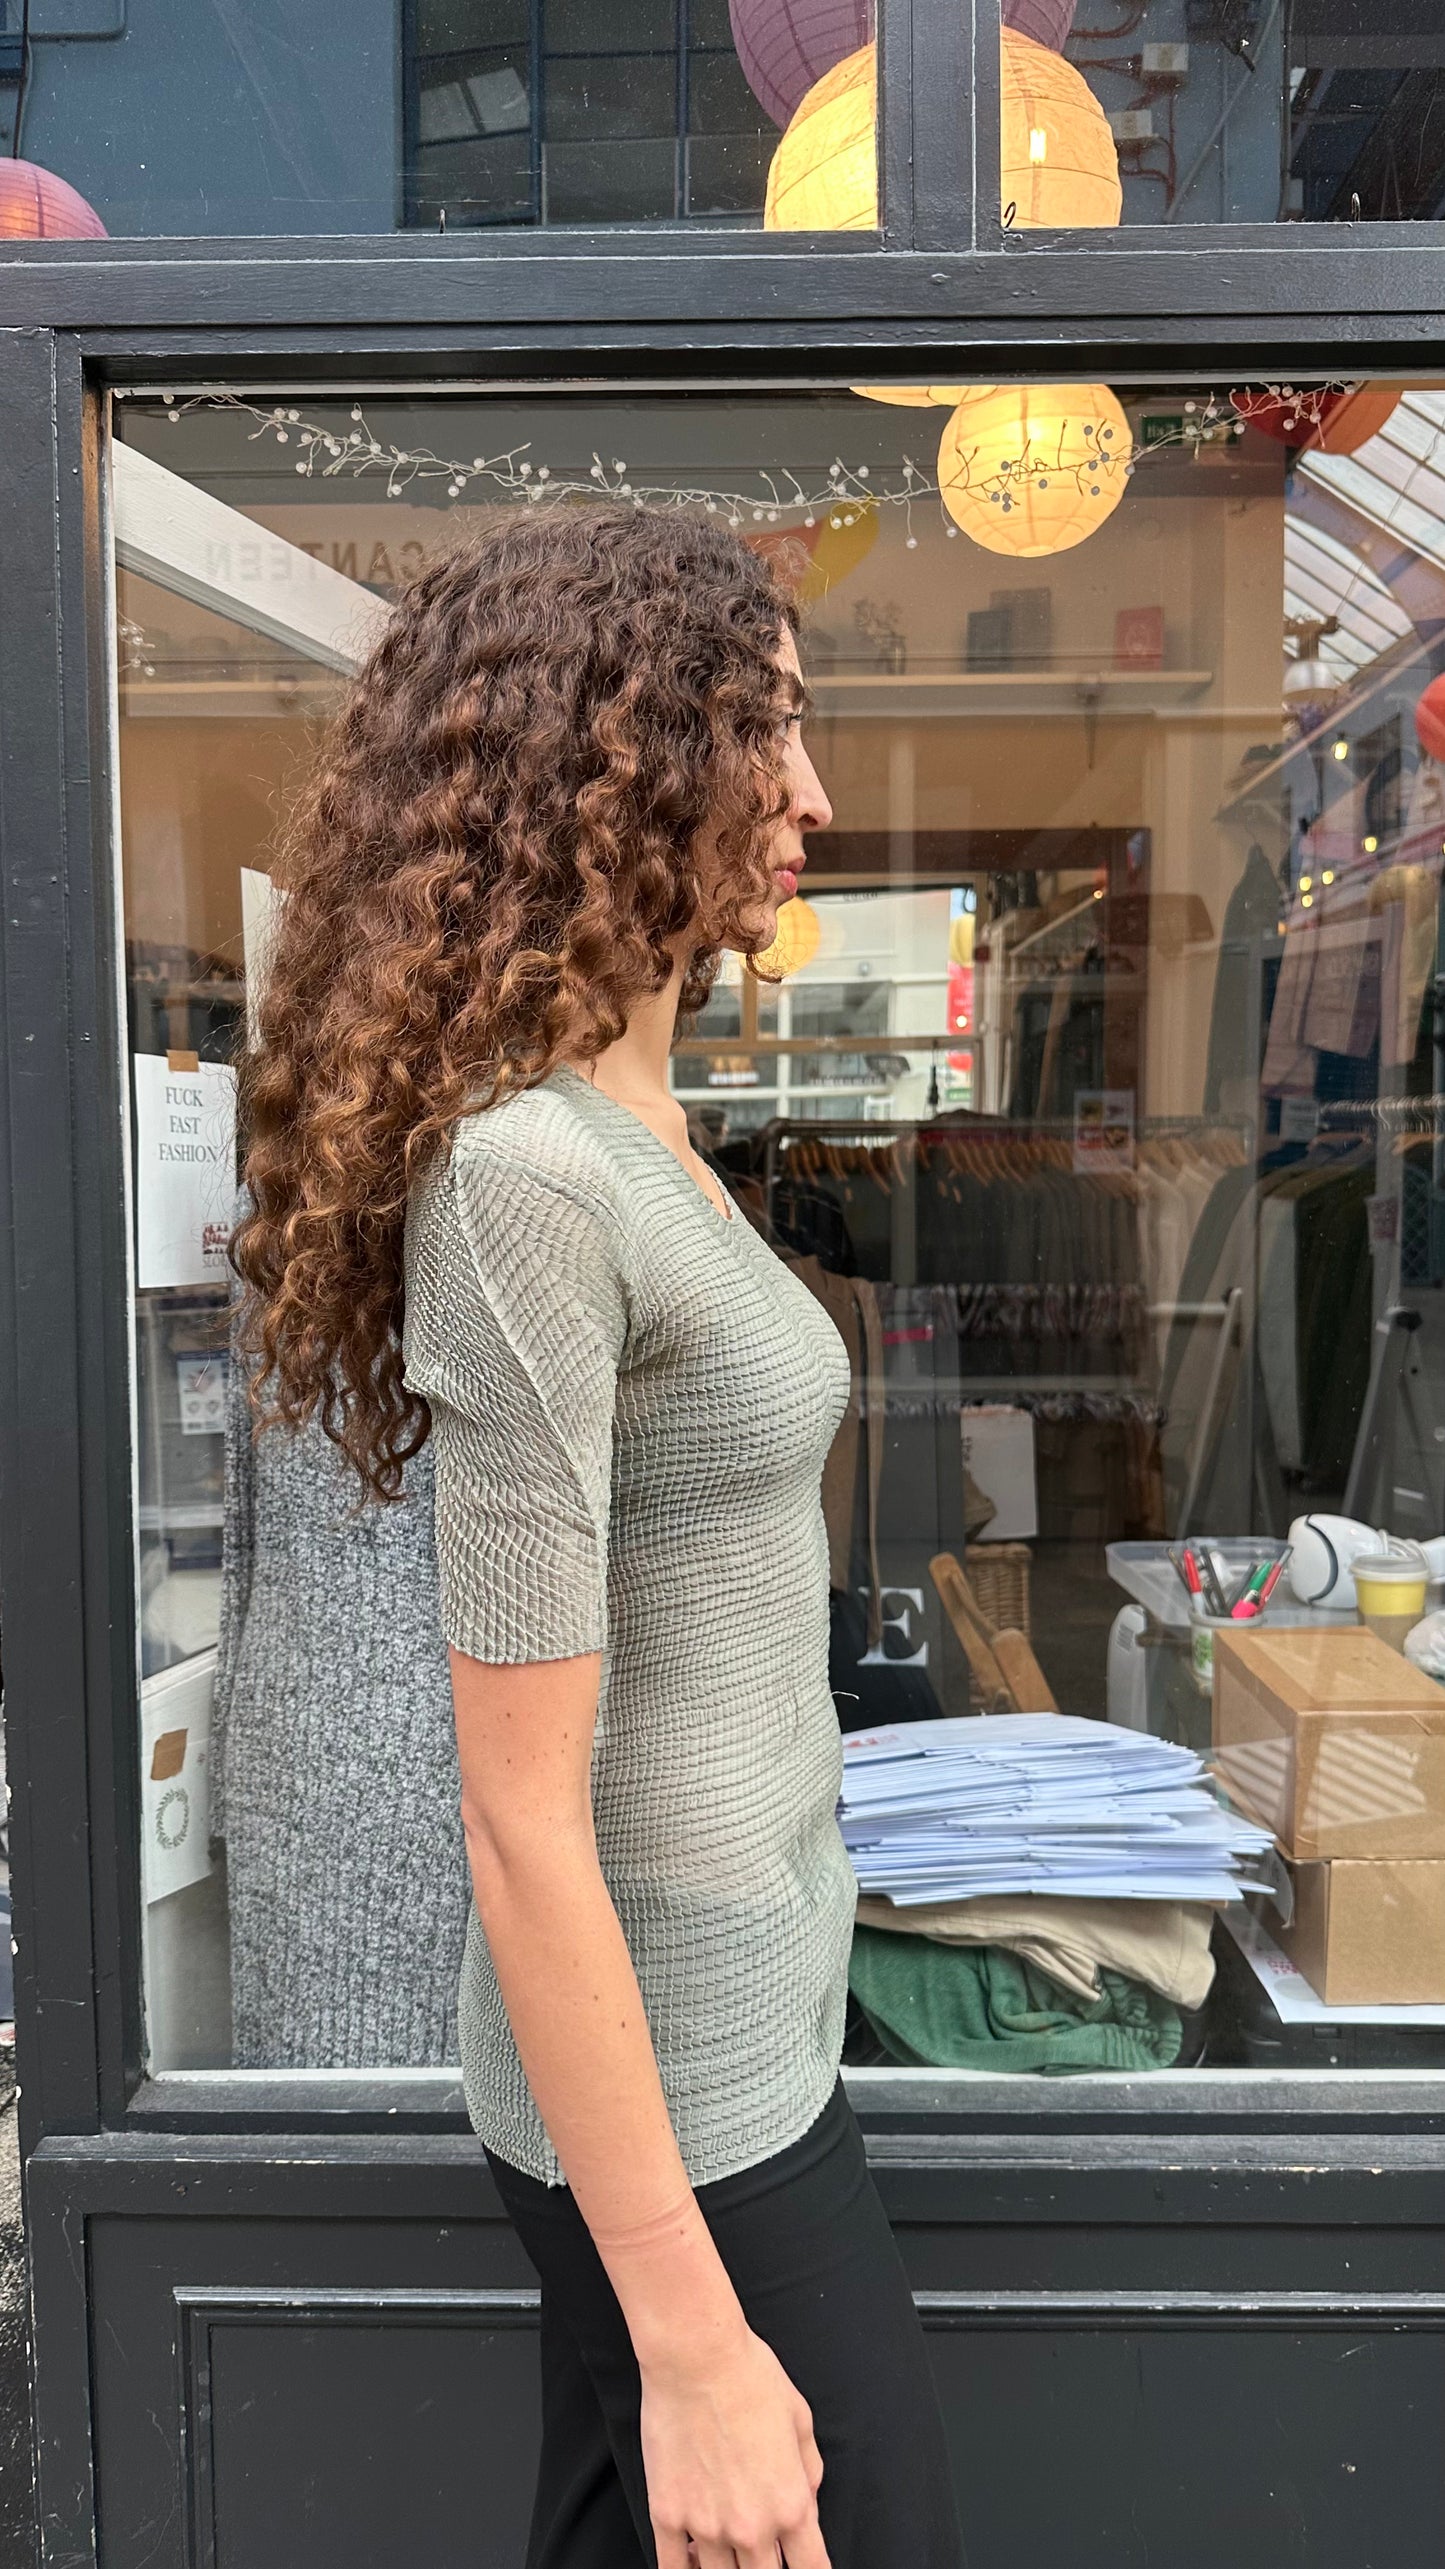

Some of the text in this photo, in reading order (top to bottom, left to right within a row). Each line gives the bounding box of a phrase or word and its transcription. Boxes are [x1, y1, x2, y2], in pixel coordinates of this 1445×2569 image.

[165, 1086, 204, 1107] FUCK
[169, 1114, 201, 1135] FAST
[158, 1142, 218, 1163] FASHION
[856, 1585, 929, 1668] E
